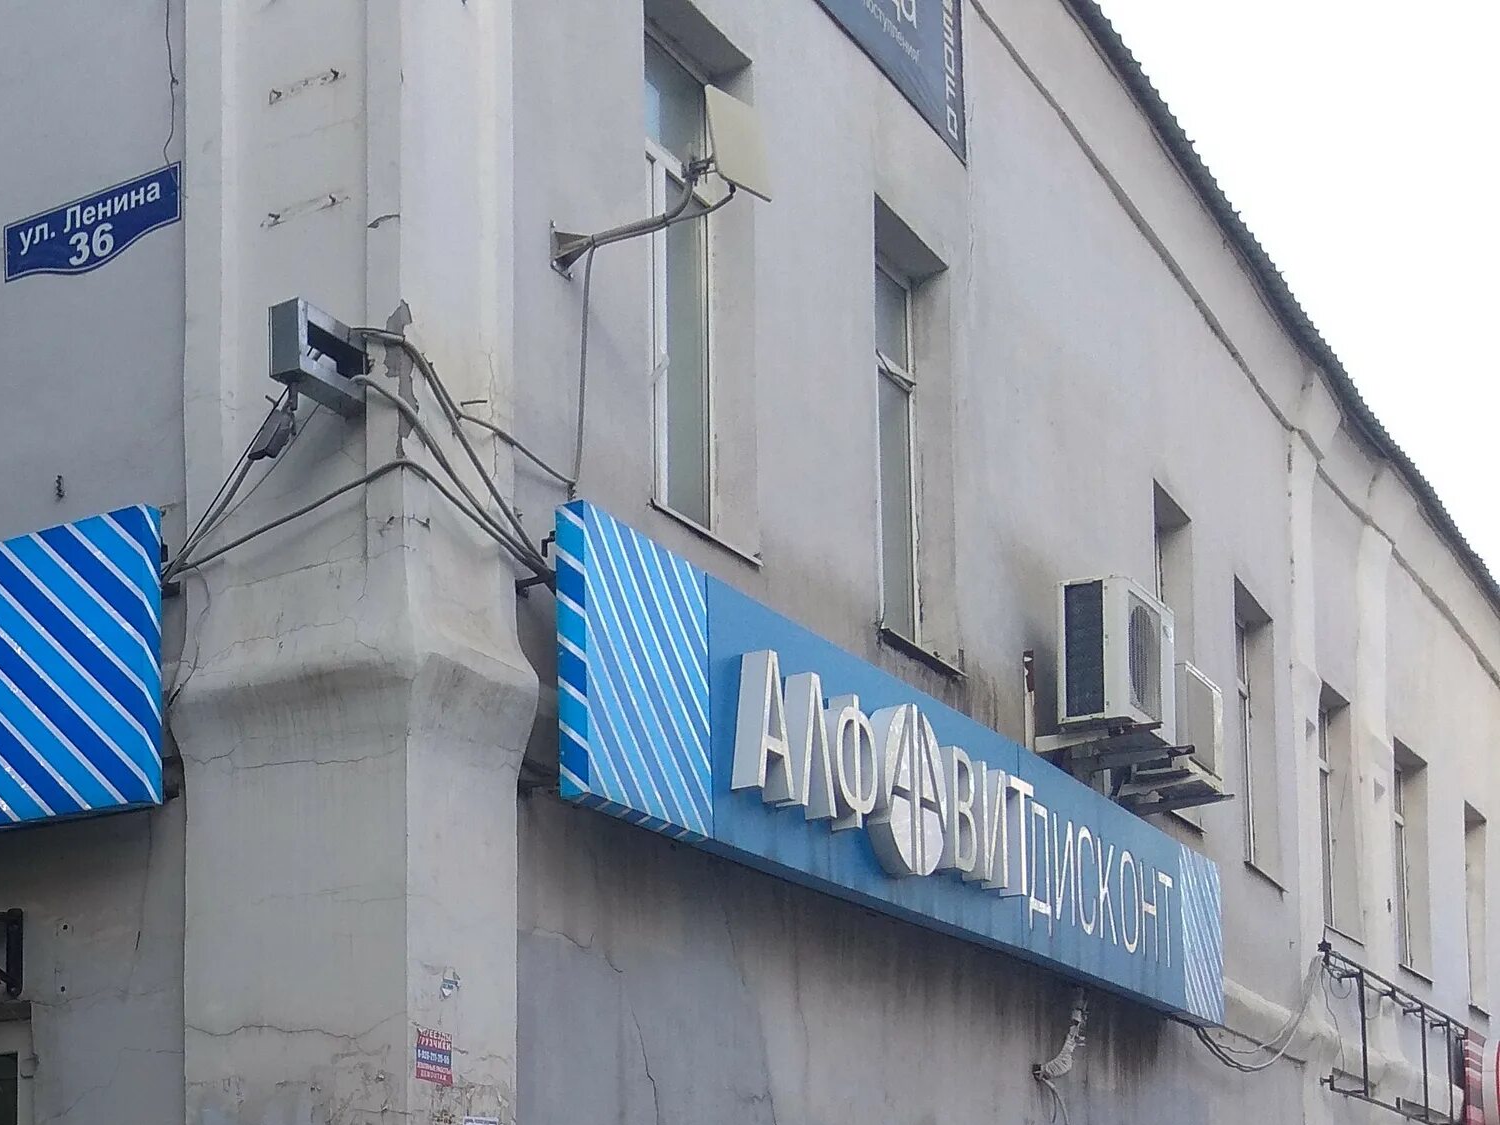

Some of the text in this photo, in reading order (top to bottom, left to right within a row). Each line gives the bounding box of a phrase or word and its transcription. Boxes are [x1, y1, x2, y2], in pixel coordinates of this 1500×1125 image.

[19, 181, 161, 256] ул. Ленина
[68, 222, 114, 266] 36
[731, 649, 1175, 968] АЛФАВИТ ДИСКОНТ
